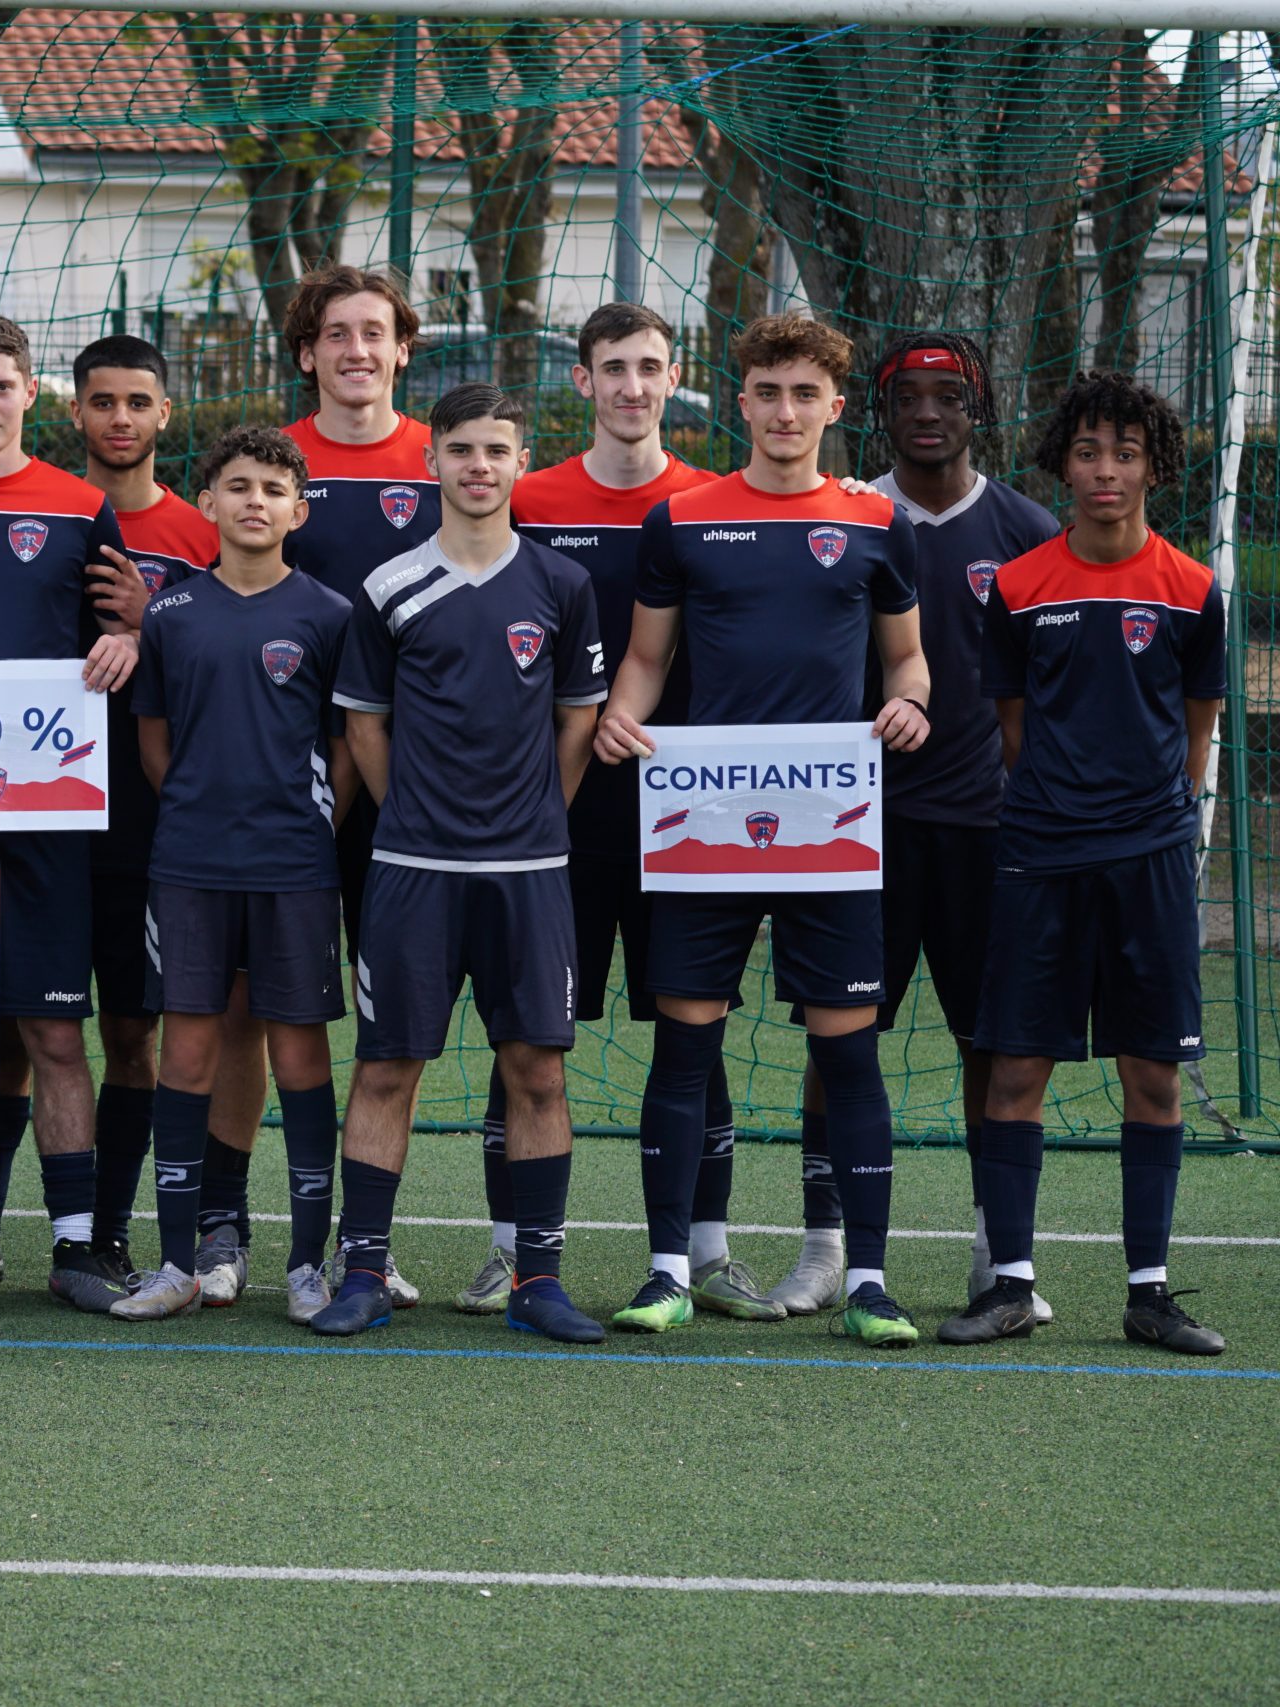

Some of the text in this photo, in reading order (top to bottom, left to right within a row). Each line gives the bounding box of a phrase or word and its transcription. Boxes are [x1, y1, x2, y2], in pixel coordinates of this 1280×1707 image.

[551, 535, 599, 548] uhlsport
[703, 530, 757, 542] uhlsport
[385, 563, 424, 587] PATRICK
[150, 590, 192, 616] SPROX
[1036, 611, 1080, 626] uhlsport
[23, 706, 74, 752] %
[644, 762, 876, 791] CONFIANTS !
